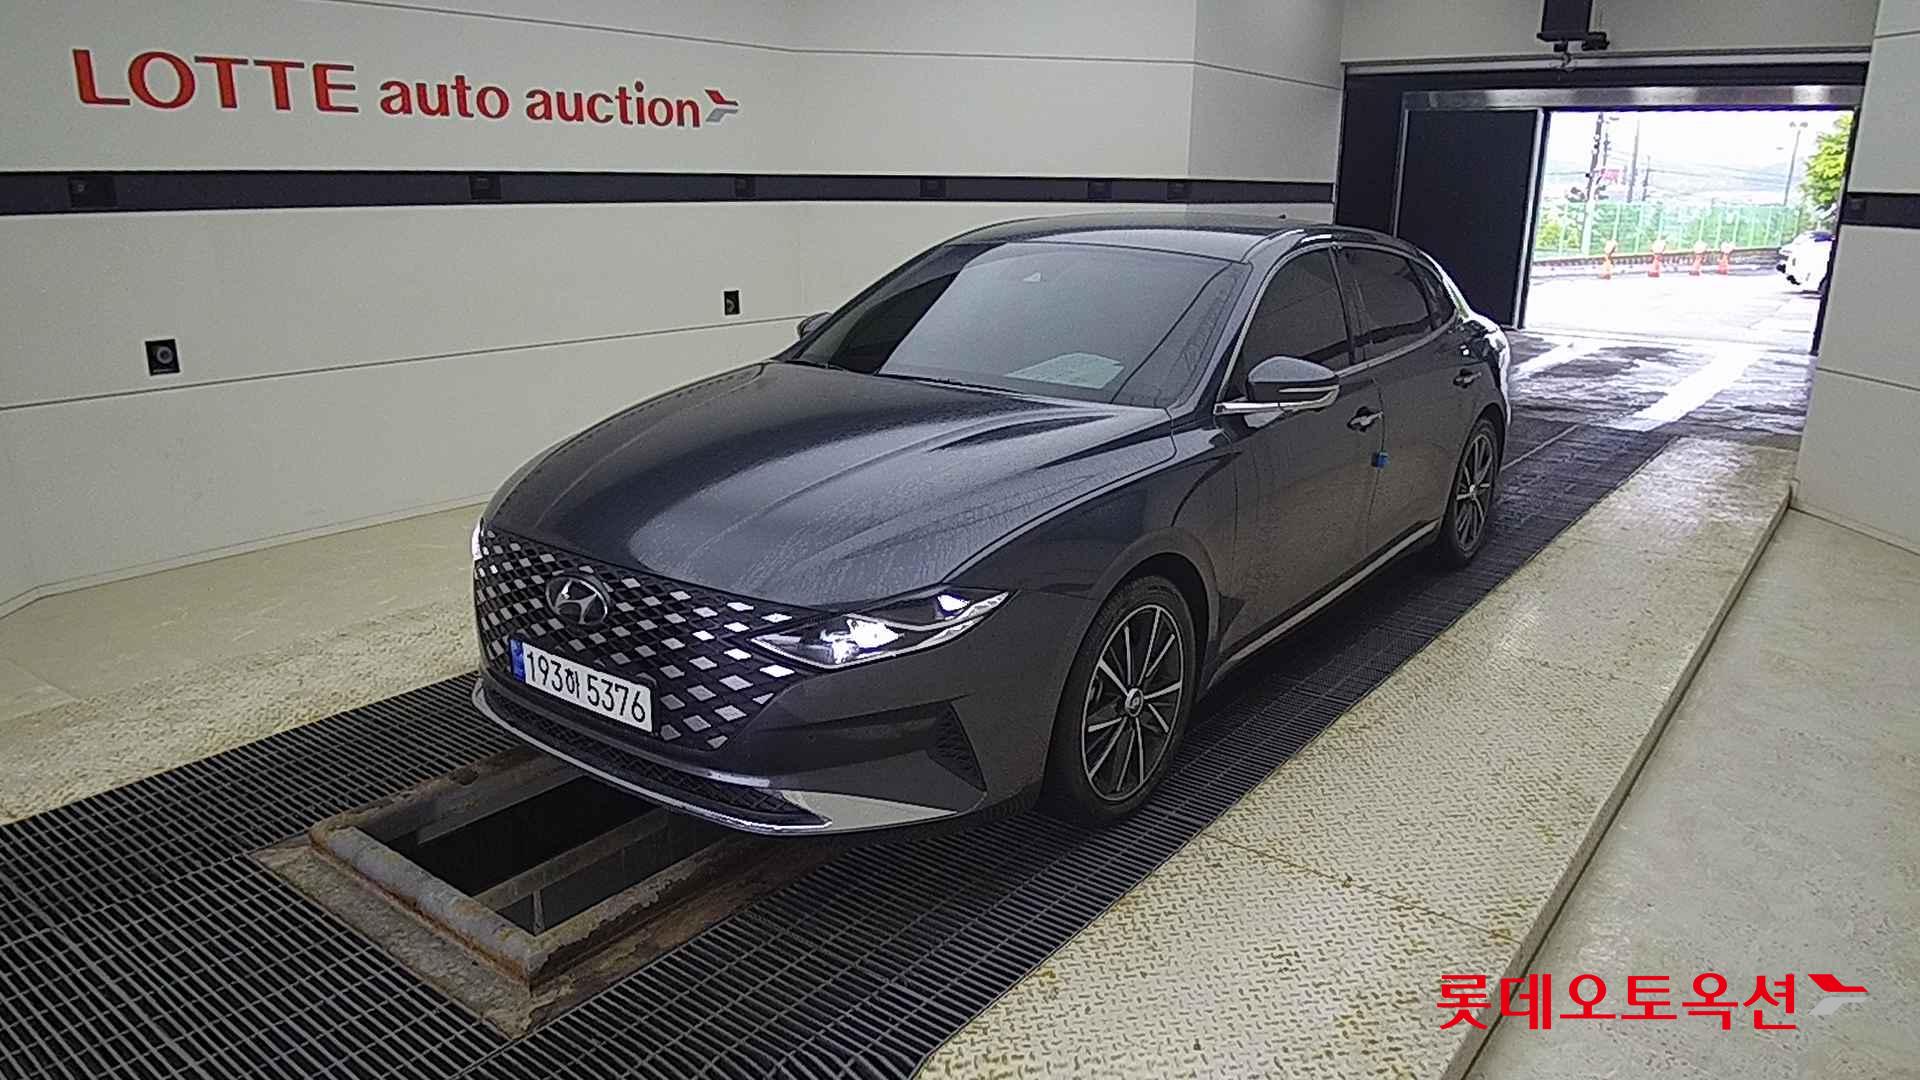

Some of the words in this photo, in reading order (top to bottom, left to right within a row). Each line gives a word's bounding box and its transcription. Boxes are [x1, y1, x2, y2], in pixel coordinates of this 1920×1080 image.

[73, 49, 359, 114] LOTTE
[379, 75, 510, 120] auto
[525, 81, 701, 127] auction
[526, 652, 580, 699] 193하
[587, 674, 646, 723] 5376
